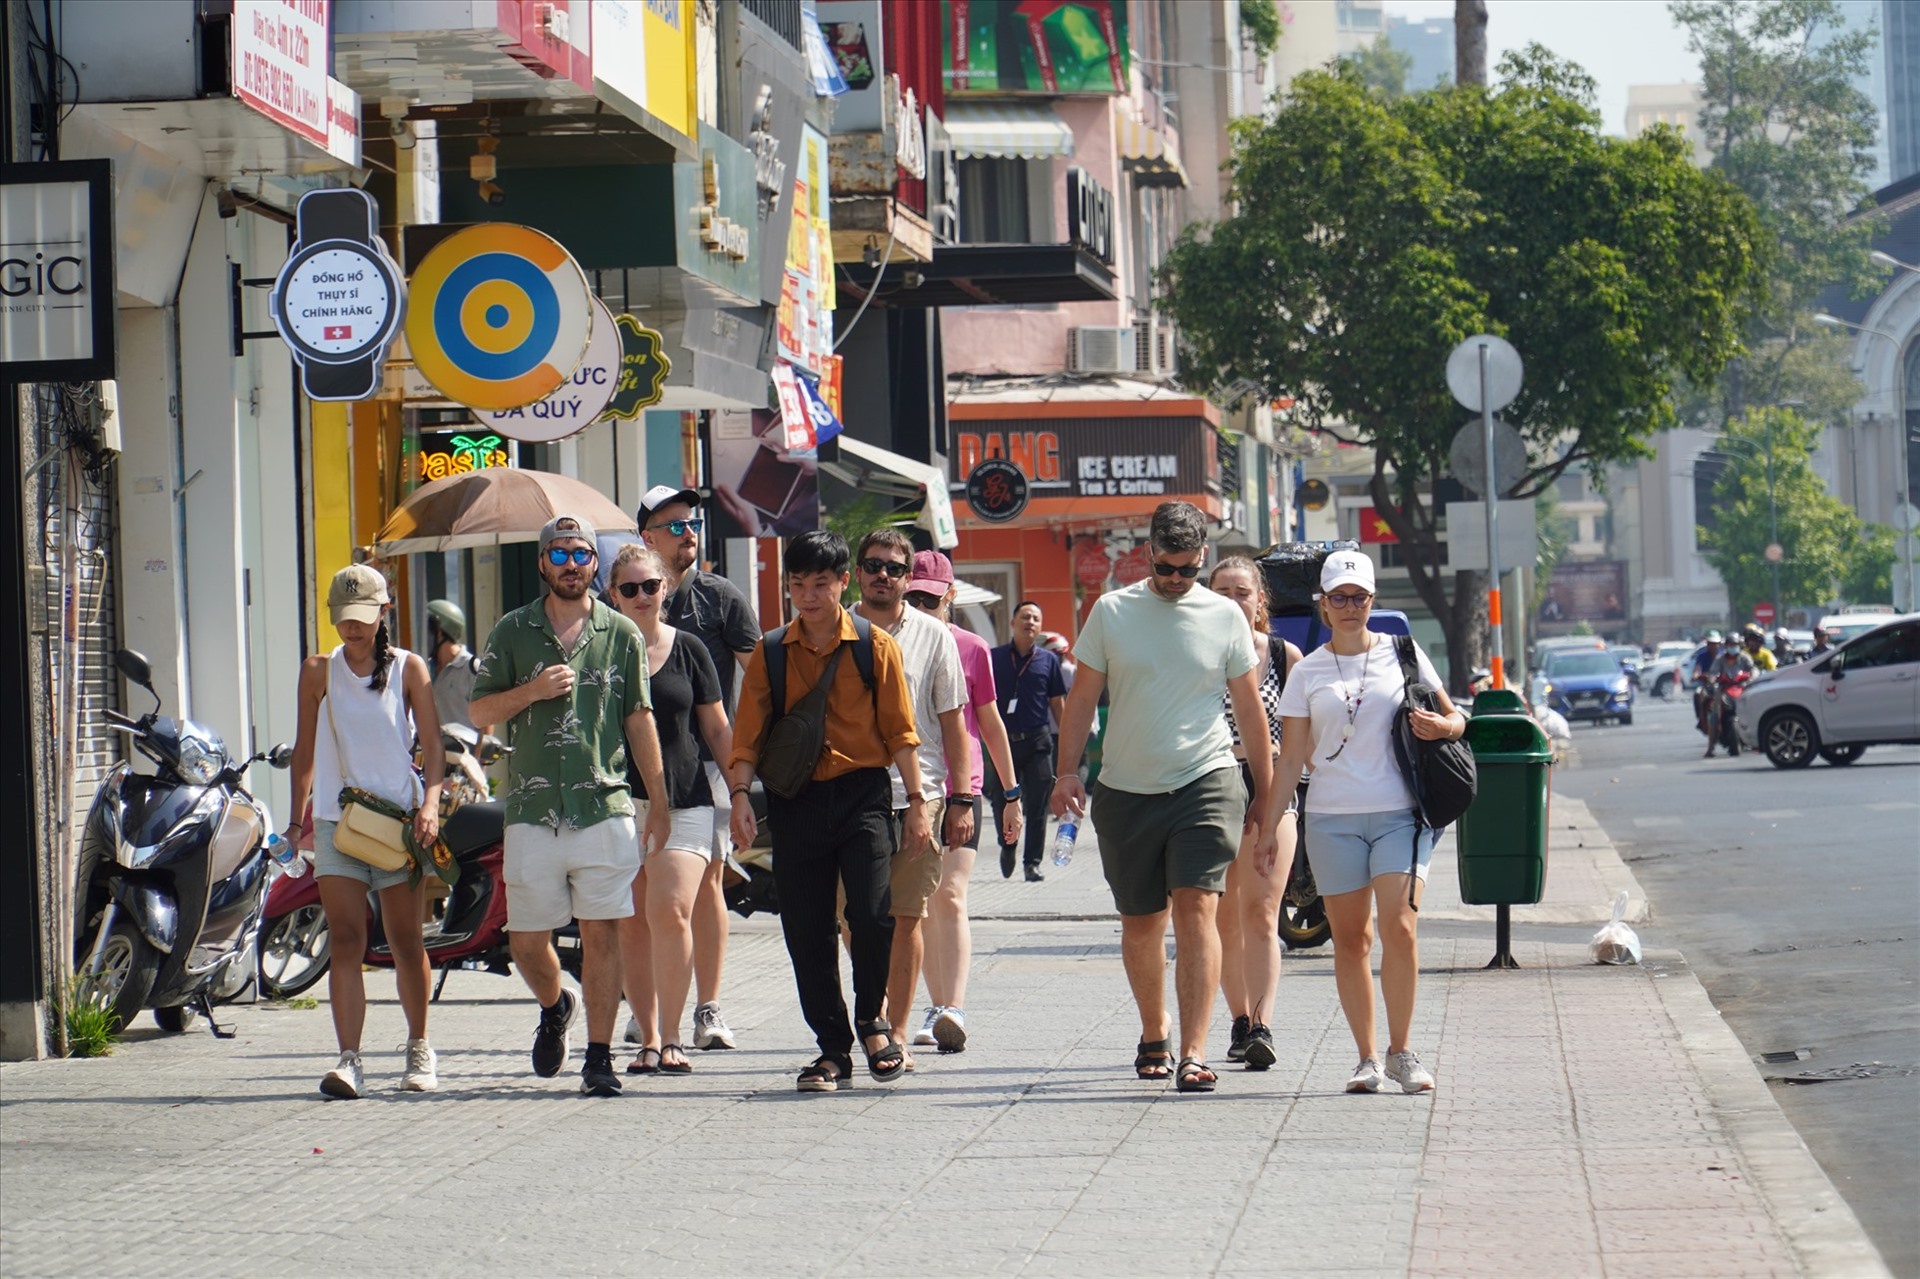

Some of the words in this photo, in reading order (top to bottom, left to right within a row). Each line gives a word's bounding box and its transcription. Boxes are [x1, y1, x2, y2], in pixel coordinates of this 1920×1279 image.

[302, 307, 337, 318] CHÍNH
[532, 395, 582, 419] QUÝ
[1078, 456, 1107, 479] ICE
[1110, 455, 1177, 479] CREAM
[1078, 480, 1104, 496] Tea
[1105, 480, 1118, 495] &
[1119, 479, 1165, 495] Coffee
[1344, 561, 1356, 571] R
